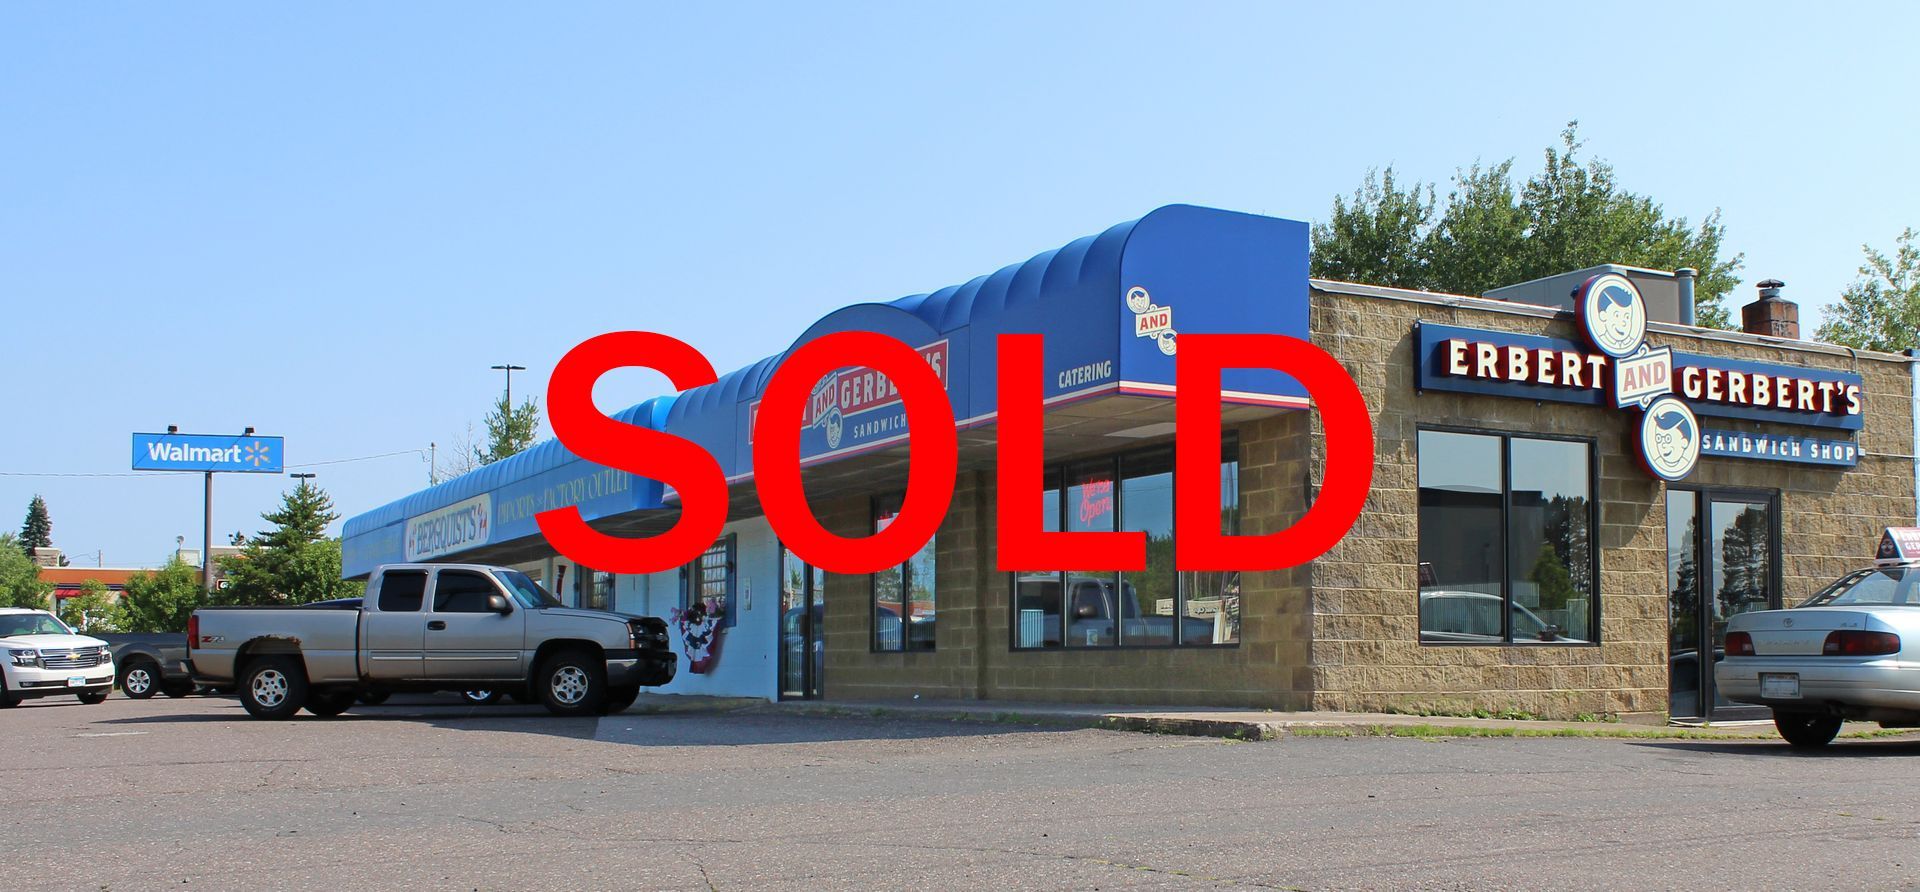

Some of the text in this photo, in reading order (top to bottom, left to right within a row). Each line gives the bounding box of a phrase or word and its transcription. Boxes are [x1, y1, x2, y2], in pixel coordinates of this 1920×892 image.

[1140, 313, 1168, 331] AND
[1058, 360, 1112, 388] CATERING
[1449, 340, 1861, 415] ERBERT AND GERBERT'S
[815, 387, 835, 417] AND
[853, 413, 906, 439] SANDWICH
[148, 442, 241, 463] Walmart
[1702, 434, 1855, 461] SANDWICH SHOP
[588, 467, 628, 499] OUTLET
